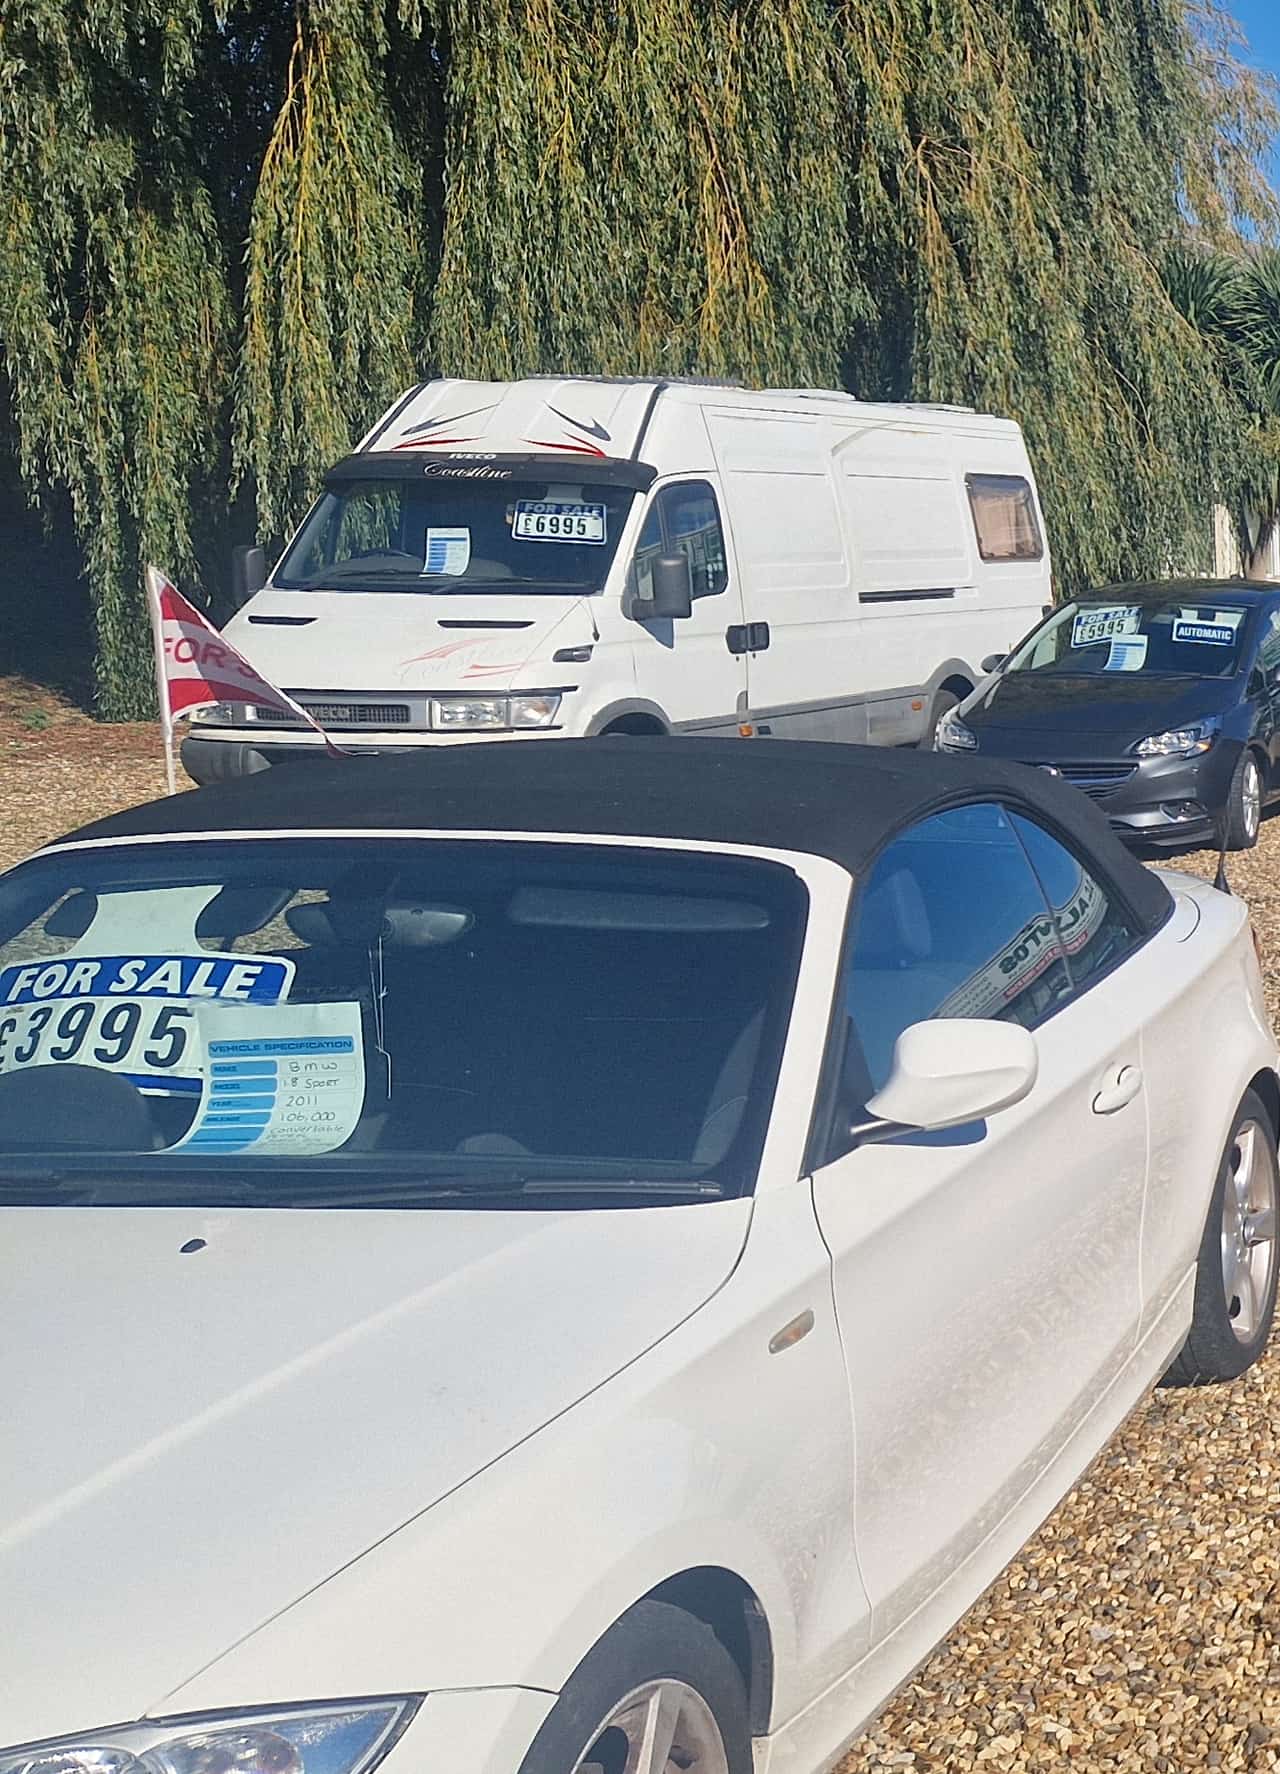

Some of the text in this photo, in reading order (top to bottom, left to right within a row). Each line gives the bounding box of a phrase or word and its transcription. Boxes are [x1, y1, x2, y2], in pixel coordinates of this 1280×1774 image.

[424, 461, 513, 480] Coastline
[524, 503, 601, 516] FOR SALE
[523, 516, 587, 536] £6995
[1082, 613, 1105, 626] FOR
[1178, 626, 1233, 641] AUTOMATIC
[7, 959, 263, 1002] FOR SALE
[210, 1040, 352, 1053] VEHICLE SPECIFICATION
